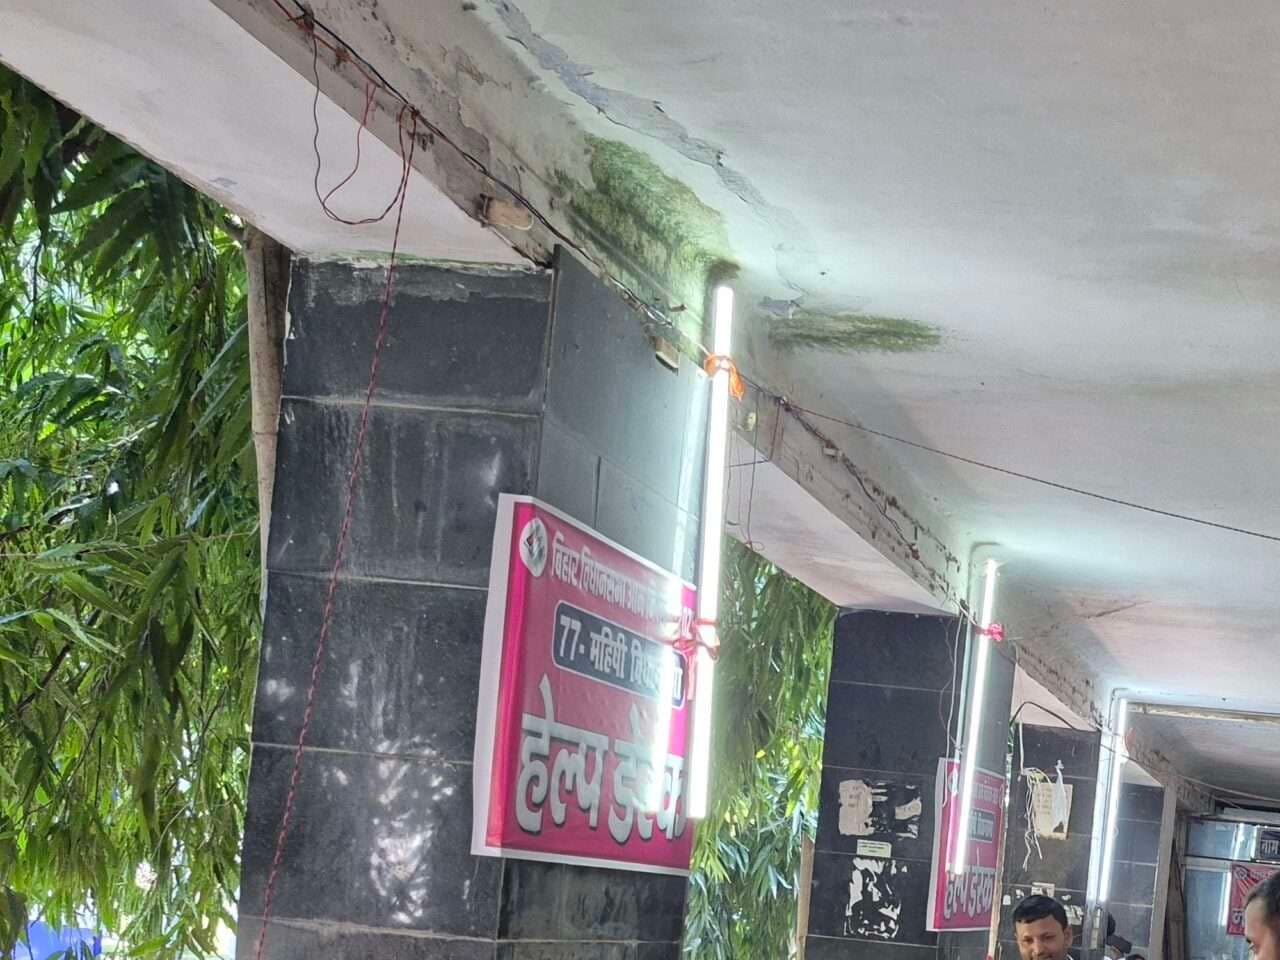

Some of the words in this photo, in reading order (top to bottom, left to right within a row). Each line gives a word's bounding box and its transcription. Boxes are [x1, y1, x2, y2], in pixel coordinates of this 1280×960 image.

[552, 531, 580, 585] बिहार
[515, 673, 609, 836] हेल्प
[1261, 839, 1279, 855] नाम
